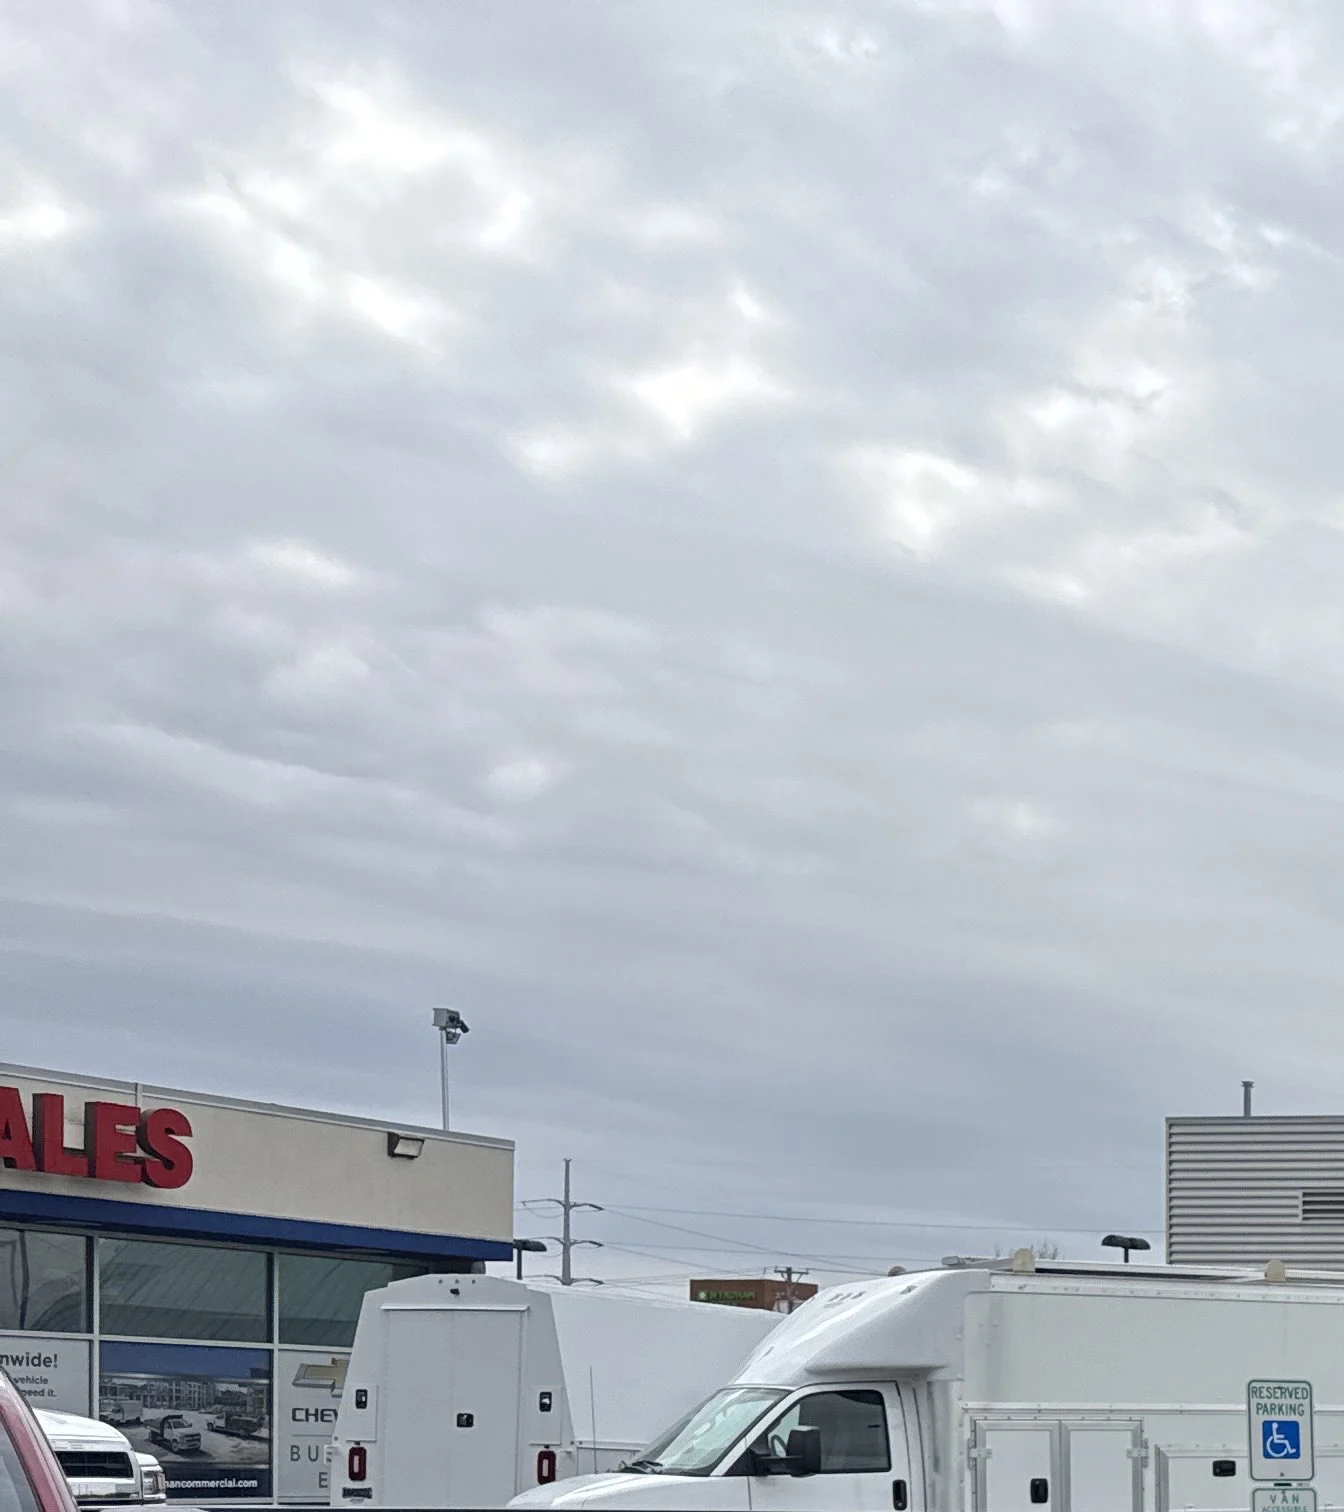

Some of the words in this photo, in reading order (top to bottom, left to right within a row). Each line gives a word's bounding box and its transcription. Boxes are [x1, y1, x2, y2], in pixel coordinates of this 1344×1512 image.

[0, 1086, 193, 1189] ALES
[1251, 1386, 1309, 1400] RESERVED
[1256, 1403, 1305, 1417] PARKING
[1269, 1494, 1300, 1505] VAN
